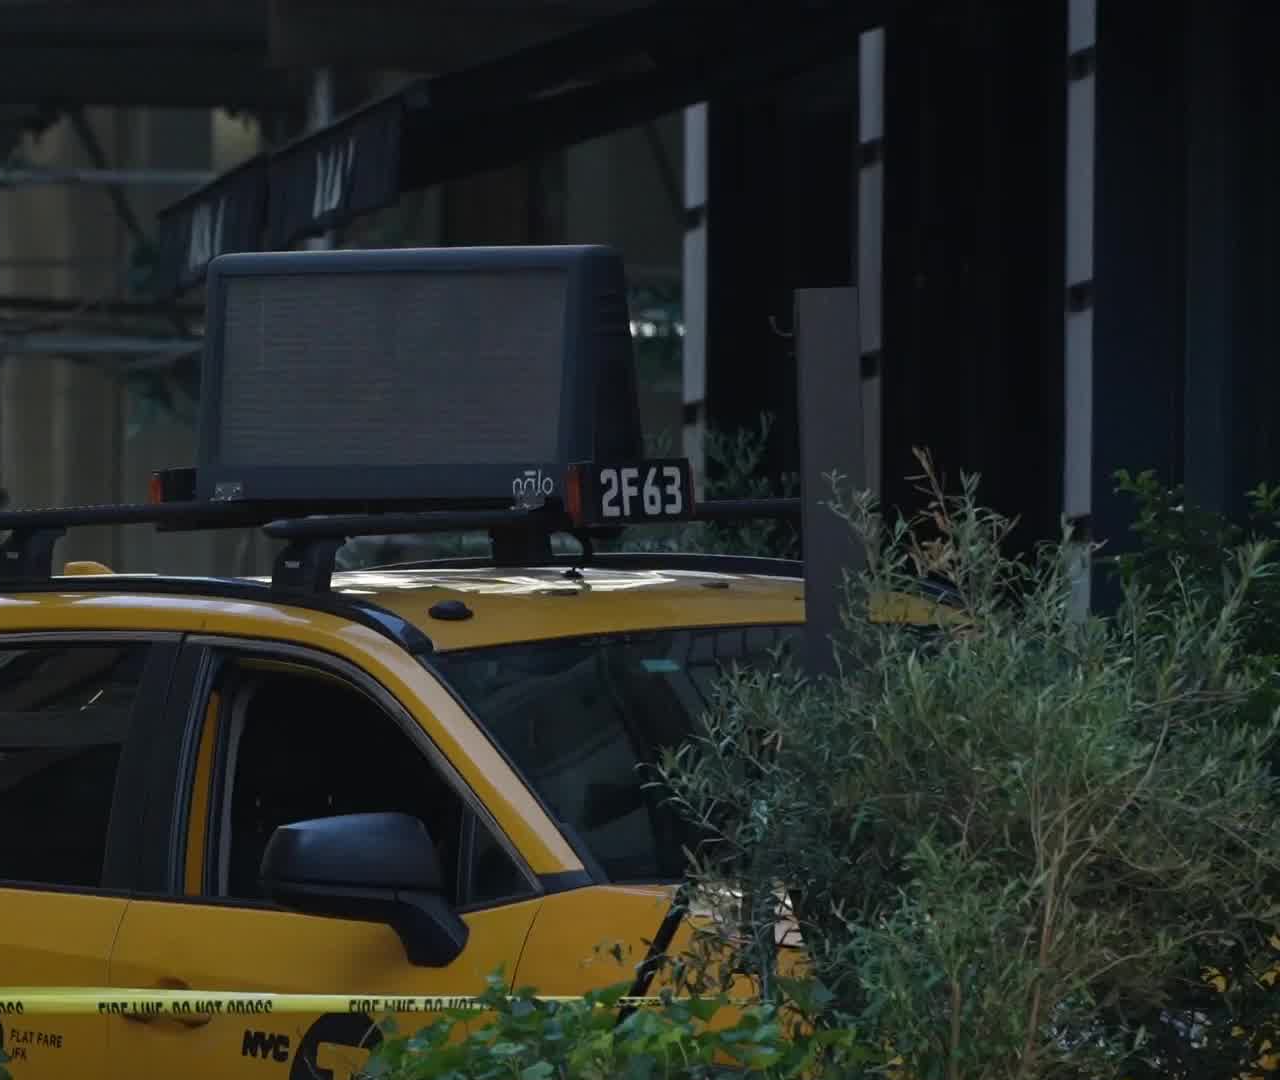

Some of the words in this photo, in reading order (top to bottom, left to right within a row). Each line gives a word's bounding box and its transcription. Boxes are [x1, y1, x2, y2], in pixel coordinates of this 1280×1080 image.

[600, 466, 683, 517] 2F63
[10, 1029, 34, 1044] FLAT
[36, 1032, 64, 1048] FARE
[241, 1029, 290, 1063] NYC
